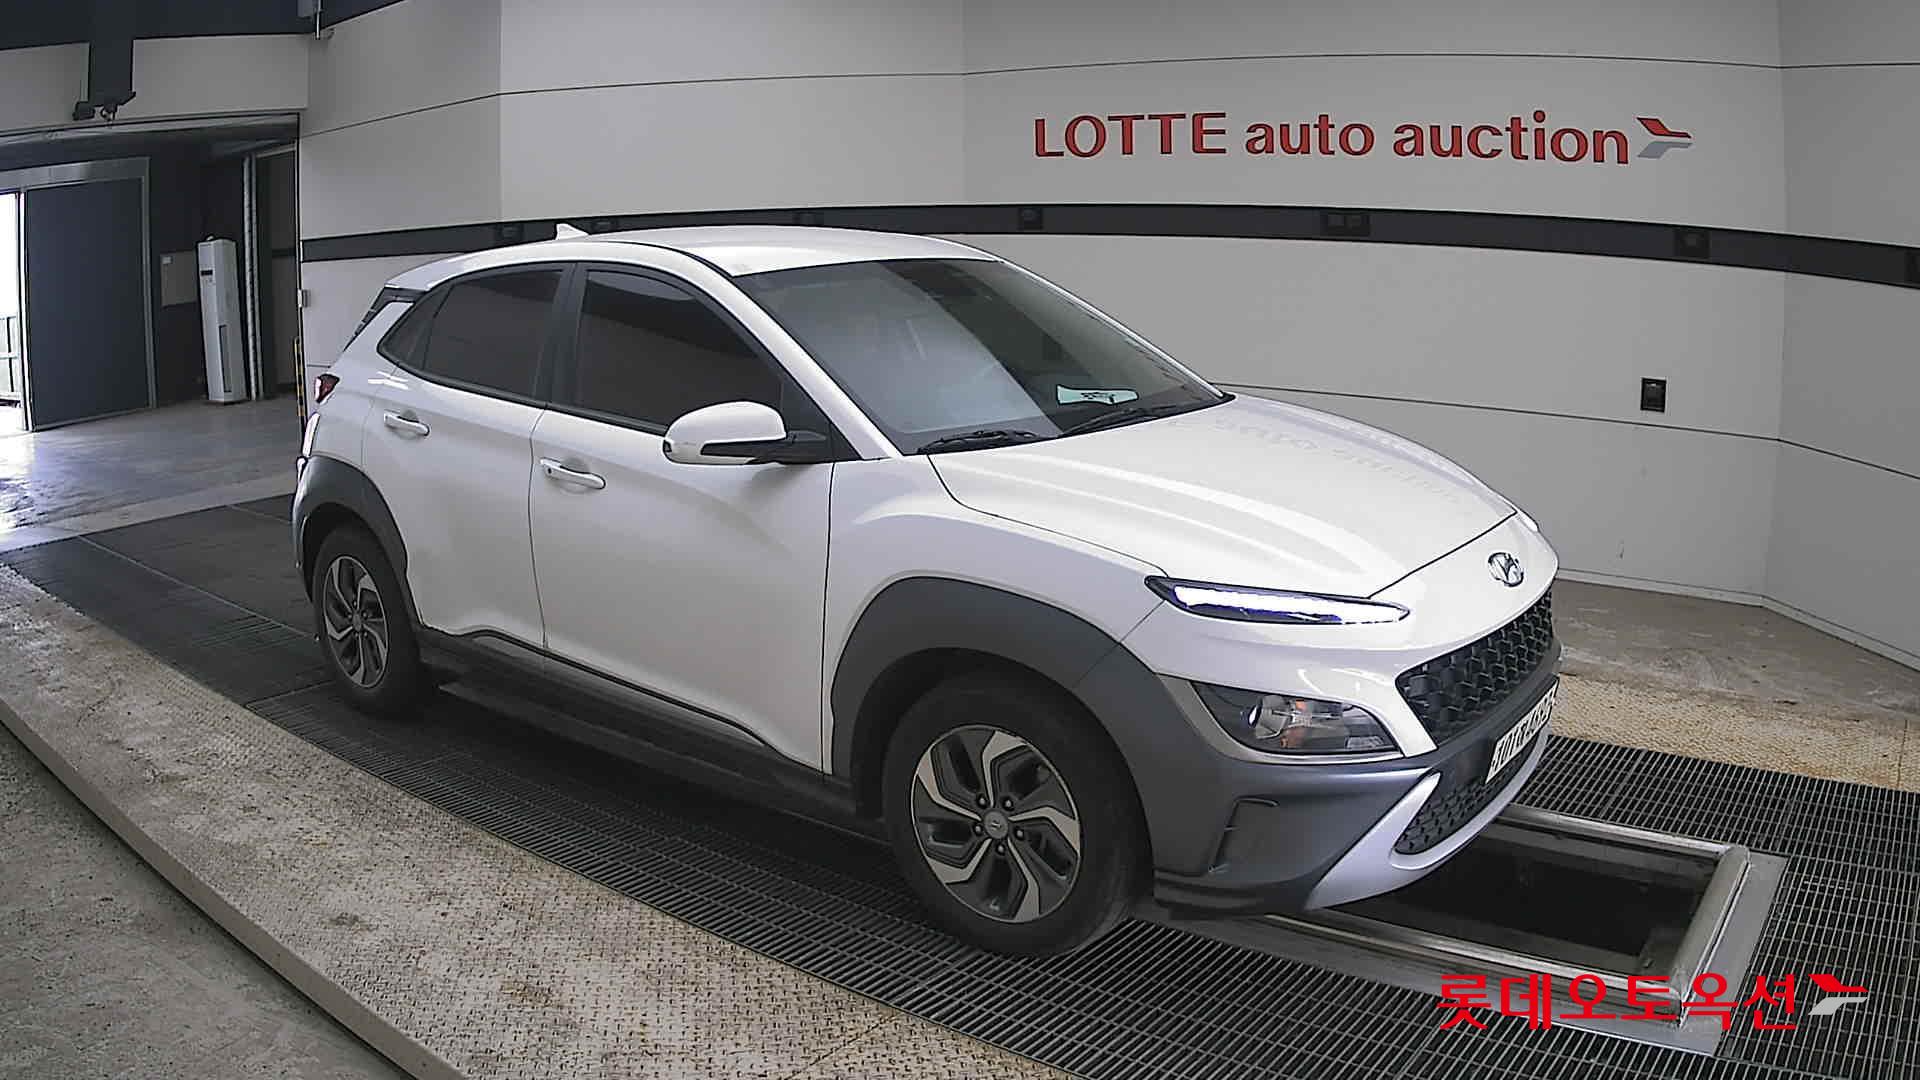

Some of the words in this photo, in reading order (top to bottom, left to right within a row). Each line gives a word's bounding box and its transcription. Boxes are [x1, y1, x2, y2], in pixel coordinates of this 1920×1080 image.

[1034, 111, 1227, 158] LOTTE
[1245, 113, 1376, 157] auto
[1392, 109, 1630, 165] auction
